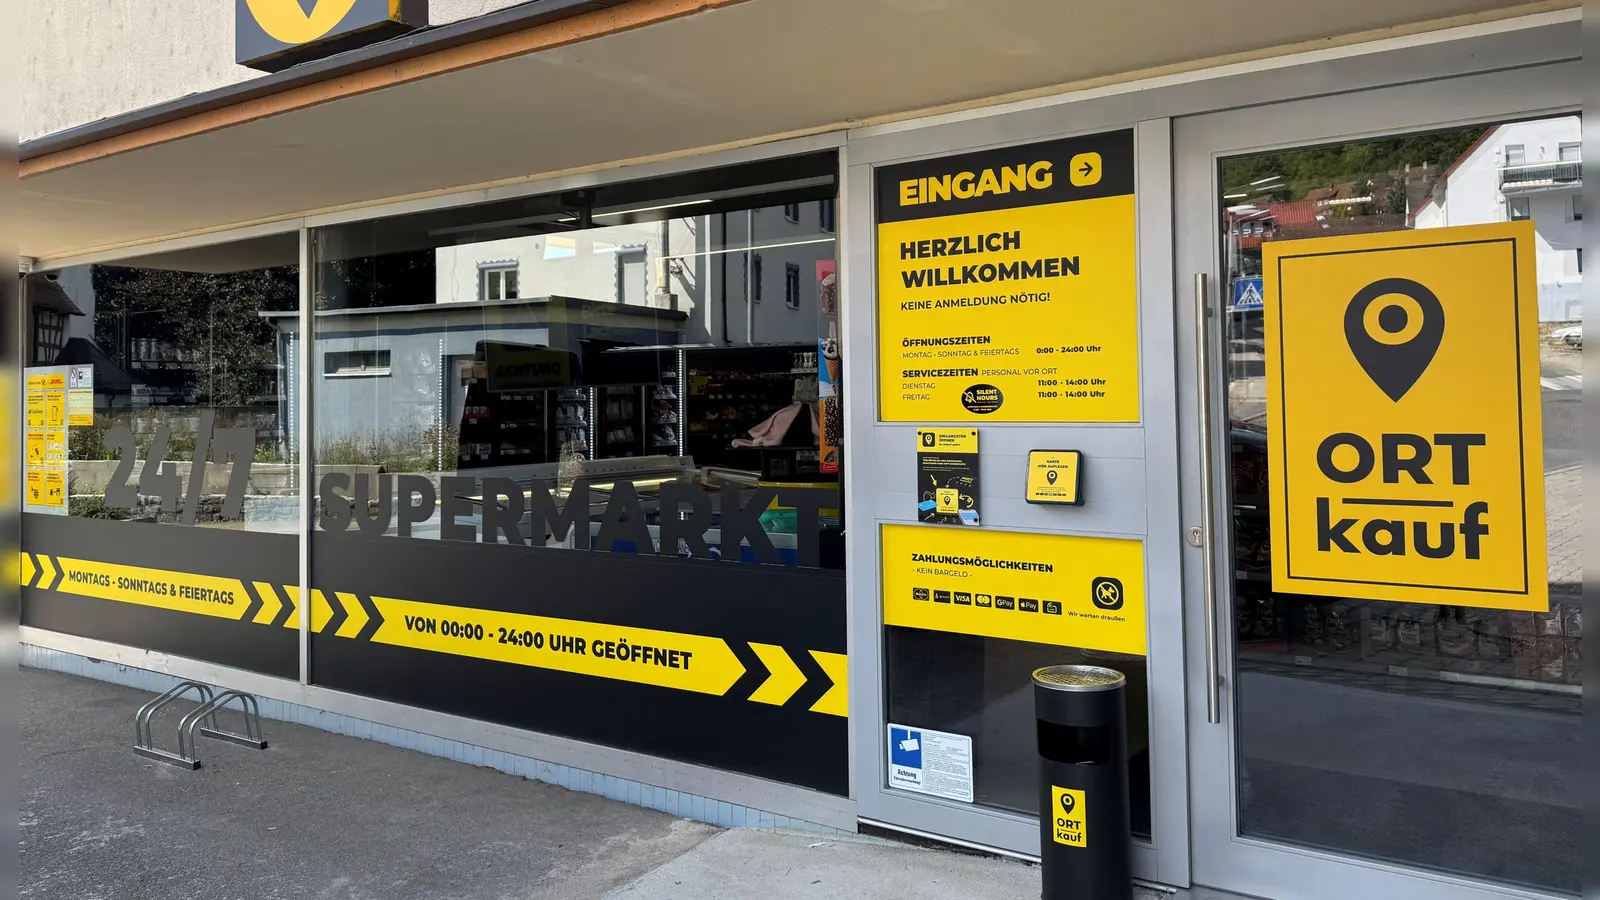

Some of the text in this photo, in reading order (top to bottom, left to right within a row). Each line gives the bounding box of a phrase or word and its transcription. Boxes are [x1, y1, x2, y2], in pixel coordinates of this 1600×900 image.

[899, 161, 1053, 207] EINGANG
[900, 230, 1021, 261] HERZLICH
[900, 254, 1080, 289] WILLKOMMEN
[900, 291, 1050, 311] KEINE ANMELDUNG NÖTIG!
[902, 335, 991, 348] ÖFFNUNGSZEITEN
[1061, 345, 1085, 353] 24:00
[1086, 344, 1102, 353] Uhr
[902, 351, 933, 359] MONTAG
[938, 349, 972, 358] SONNTAG
[980, 347, 1020, 356] FEIERTAGS
[902, 366, 1058, 378] SERVICEZEITEN PERSONAL VOR ORT
[902, 382, 936, 390] DIENSTAG
[1065, 378, 1089, 386] 14:00
[1090, 378, 1106, 386] Uhr
[902, 393, 931, 401] FREITAG
[1065, 390, 1088, 398] 14:00
[1090, 390, 1106, 398] Uhr
[1316, 432, 1487, 486] ORT
[103, 410, 257, 525] 24/7
[318, 471, 840, 568] SUPERMARKT
[1316, 496, 1490, 560] kauf
[911, 553, 1053, 574] ZAHLUNGSMÖGLICHKEITEN
[916, 567, 933, 575] KEIN
[934, 568, 969, 578] BARGELD
[68, 569, 111, 588] MONTAGS
[117, 576, 168, 596] SONNTAGS
[169, 583, 177, 597] &
[179, 585, 235, 606] FEIERTAGS
[955, 594, 971, 603] VISA
[404, 615, 437, 634] VON
[440, 619, 484, 641] 00:00
[498, 627, 544, 649] 24:00
[549, 634, 586, 655] UHR
[591, 638, 693, 670] GEÖFFNET
[897, 769, 917, 780] Achtung
[1056, 817, 1082, 830] ORT
[1056, 828, 1082, 843] kauf
